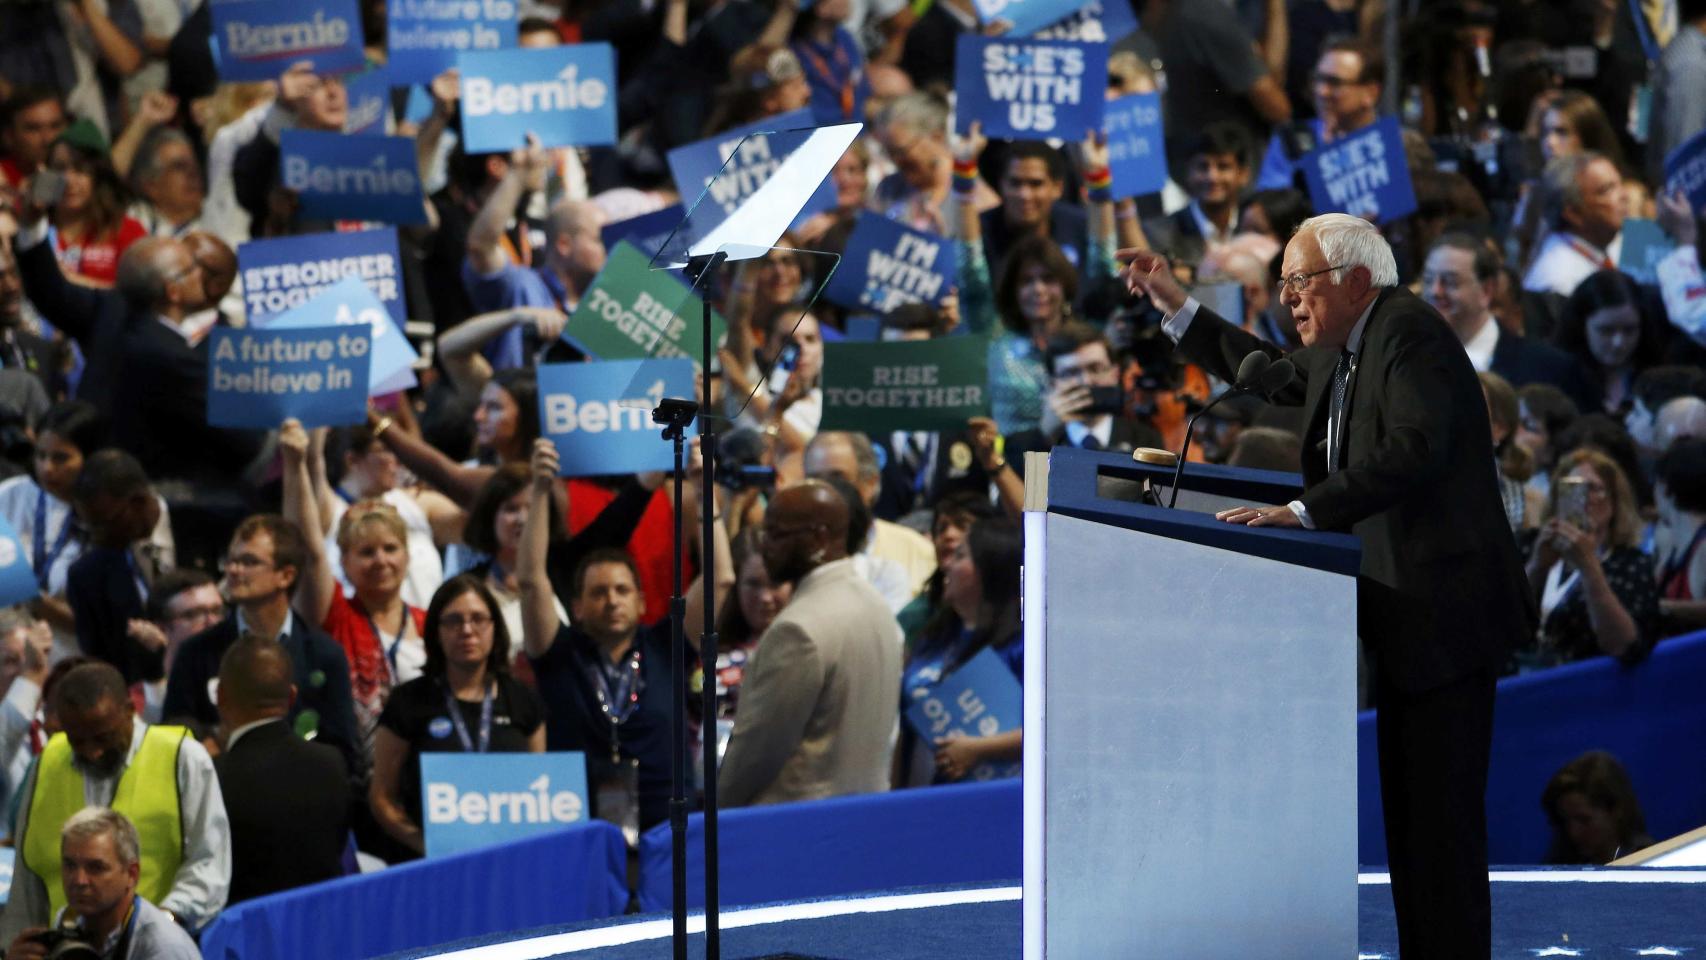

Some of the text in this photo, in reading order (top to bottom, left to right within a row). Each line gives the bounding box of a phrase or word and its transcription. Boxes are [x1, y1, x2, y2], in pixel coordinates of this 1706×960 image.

[227, 9, 349, 53] Bernie
[390, 22, 500, 51] believe in
[464, 63, 608, 117] Bernie
[985, 72, 1082, 104] WITH
[1009, 101, 1057, 131] US
[718, 134, 771, 168] I'M
[285, 154, 415, 195] Bernie
[703, 154, 784, 205] WIT
[1325, 158, 1391, 207] WITH
[895, 231, 940, 270] I'M
[867, 248, 944, 300] WITH
[632, 291, 687, 341] RISE
[215, 332, 369, 362] A future to
[213, 363, 352, 393] believe in
[873, 365, 939, 387] RISE
[544, 379, 688, 434] Berni
[826, 385, 983, 409] TOGETHER
[428, 773, 583, 825] Bernie
